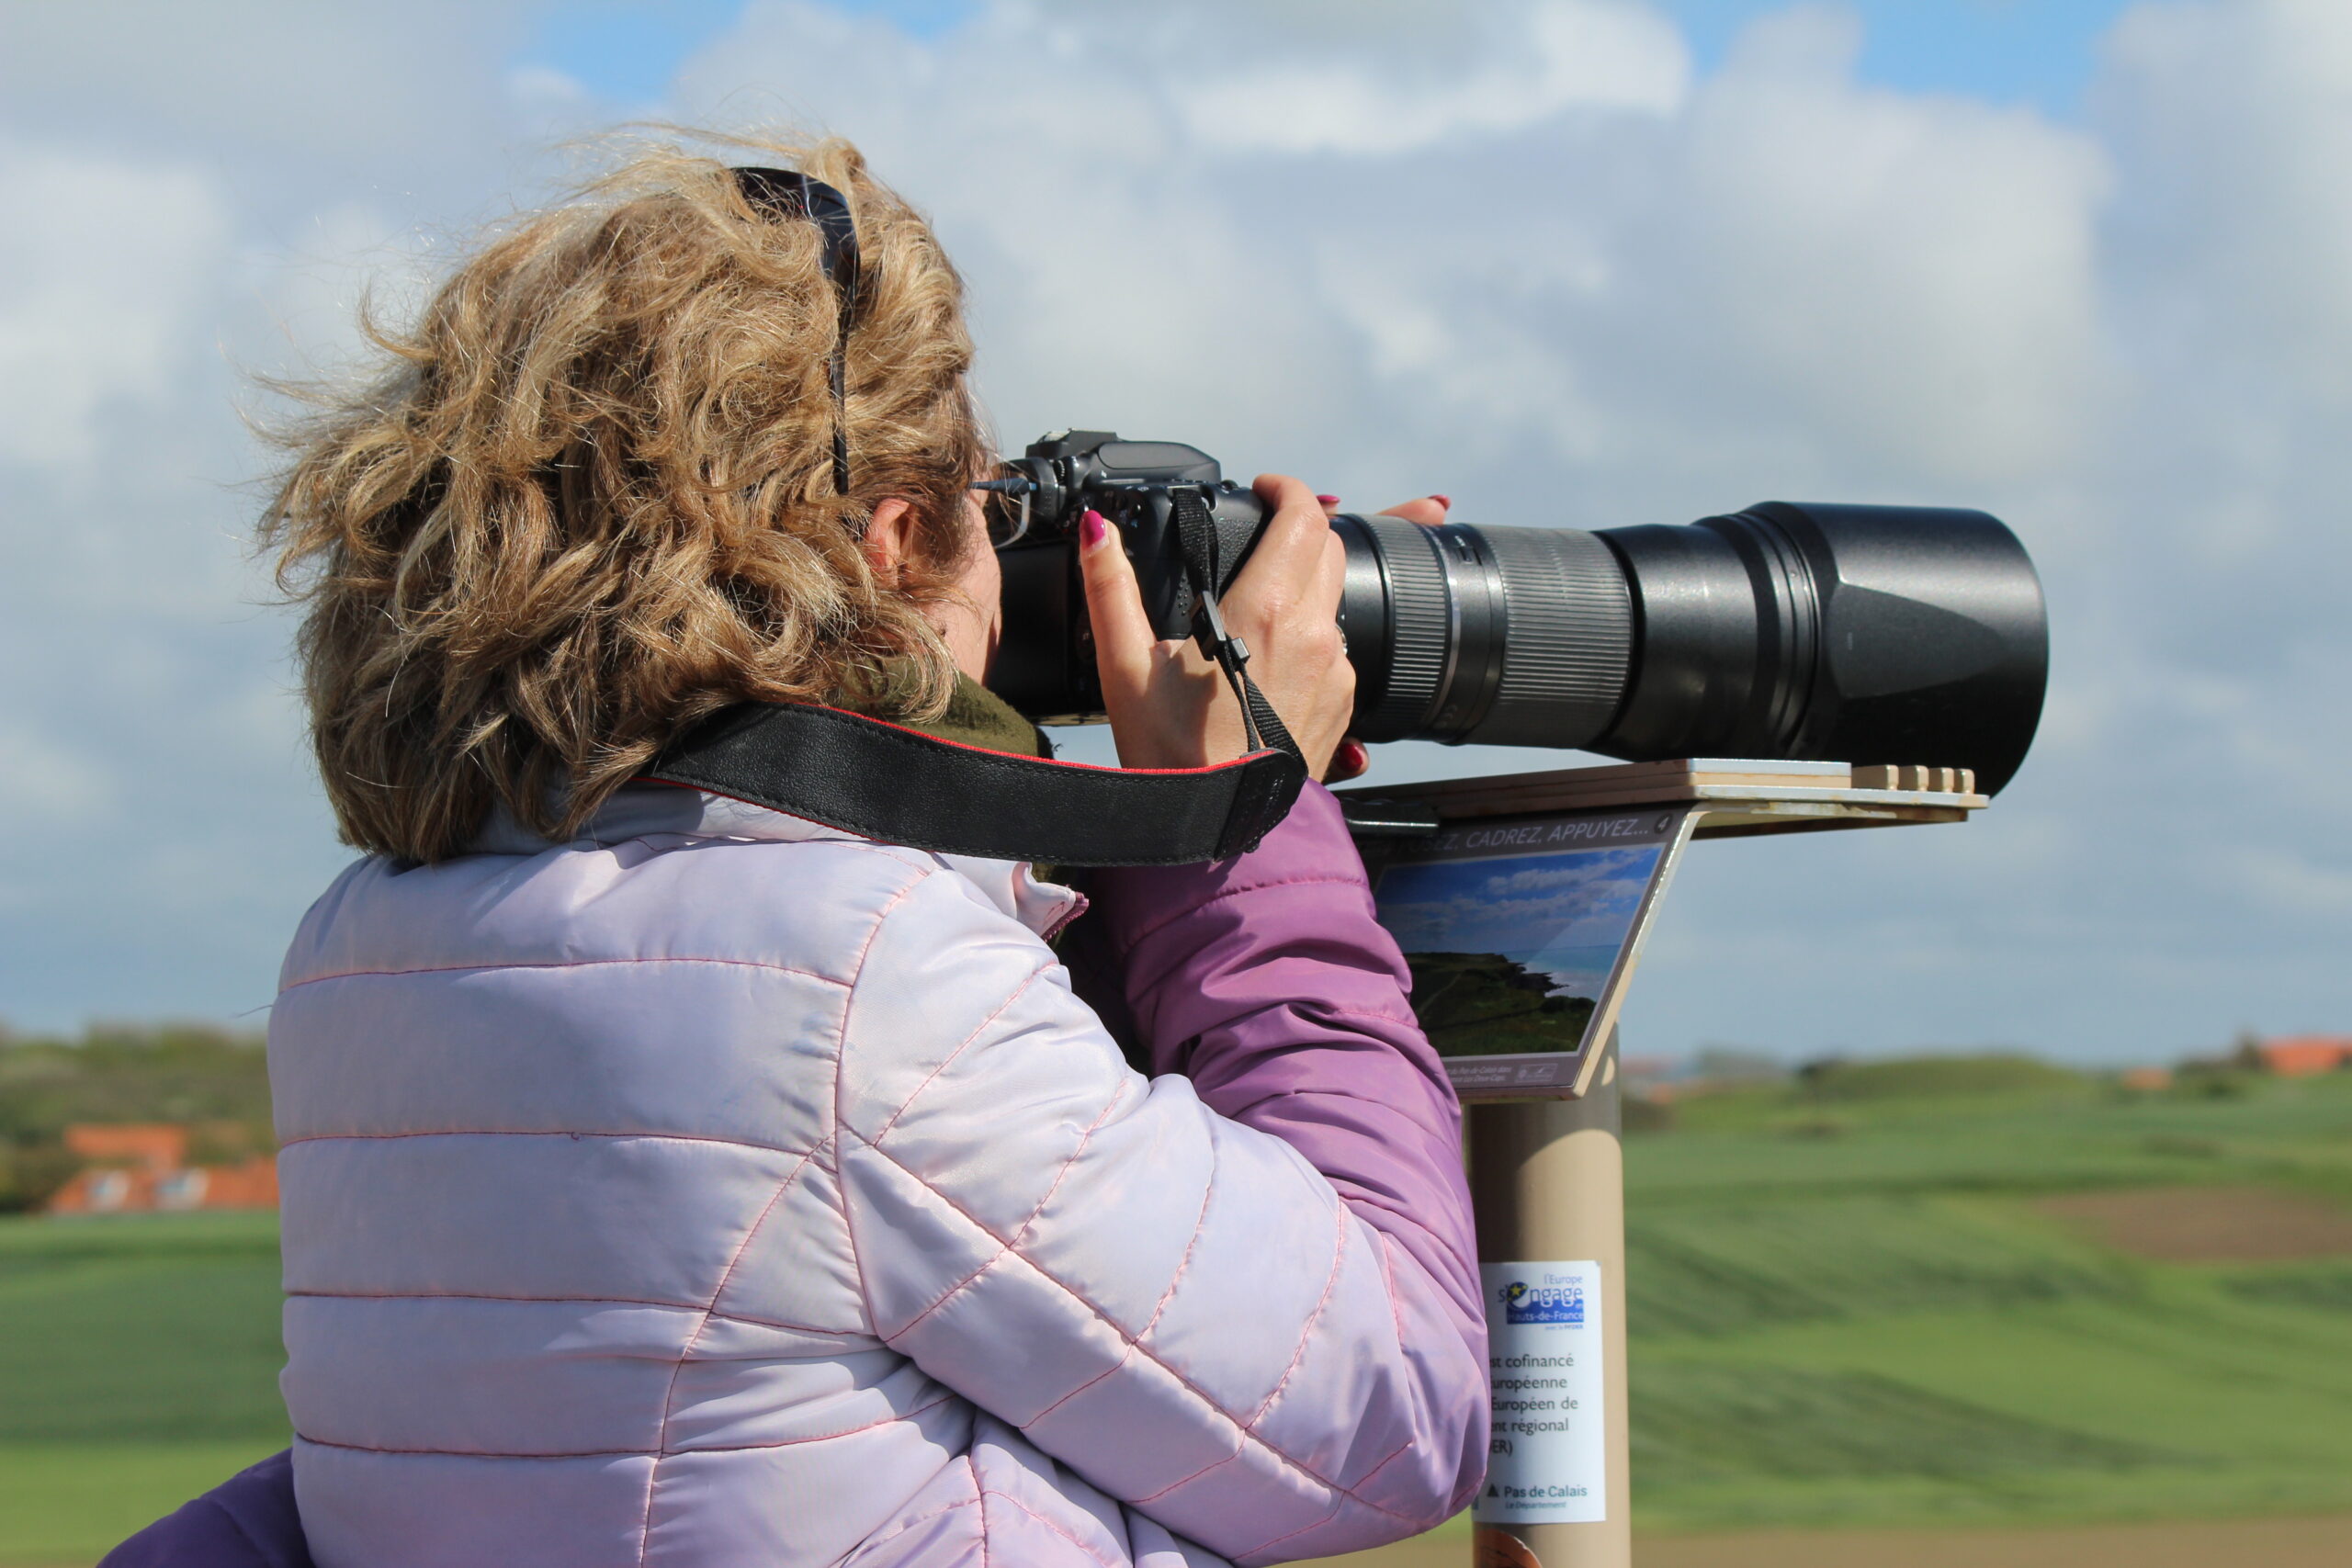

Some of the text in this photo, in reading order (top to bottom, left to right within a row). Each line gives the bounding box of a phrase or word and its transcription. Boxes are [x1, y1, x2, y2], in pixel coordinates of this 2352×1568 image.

[1657, 816, 1669, 831] 4
[1465, 827, 1542, 848] CADREZ,
[1546, 818, 1649, 842] APPUYEZ...
[1544, 1273, 1583, 1285] l'Europe
[1508, 1311, 1584, 1321] Hauts-de-France
[1489, 1353, 1574, 1368] st cofinancé
[1491, 1396, 1578, 1415] Européen de
[1511, 1417, 1569, 1436] régional
[1489, 1439, 1513, 1458] ER)
[1504, 1484, 1588, 1497] Pas de Calais
